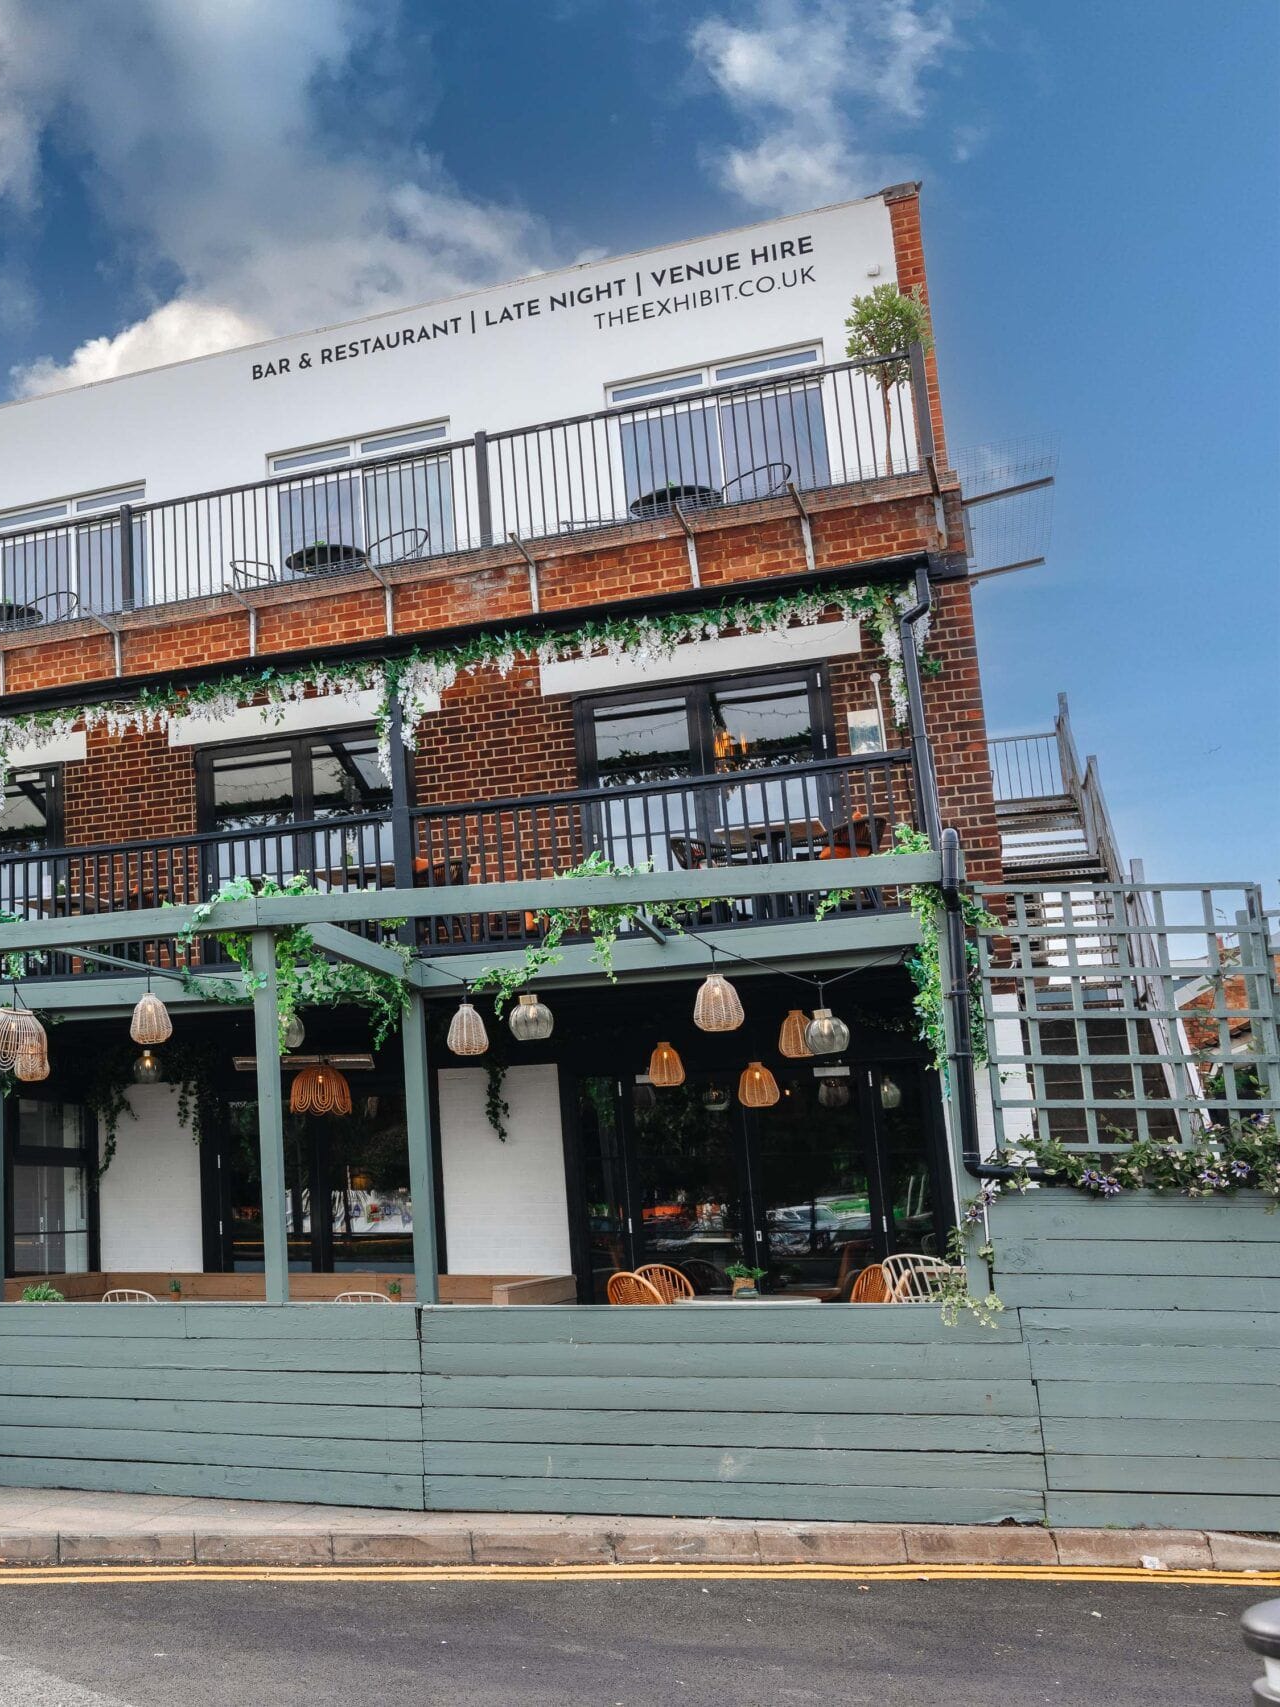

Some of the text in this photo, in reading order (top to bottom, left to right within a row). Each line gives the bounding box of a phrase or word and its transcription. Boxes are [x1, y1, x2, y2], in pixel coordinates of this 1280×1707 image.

[252, 358, 291, 380] BAR
[298, 353, 313, 369] &
[321, 317, 462, 365] RESTAURANT
[485, 299, 541, 327] LATE
[549, 278, 626, 312] NIGHT
[650, 252, 741, 288] VENUE
[750, 235, 814, 266] HIRE
[593, 265, 817, 330] THEEXHIBIT.CO.UK
